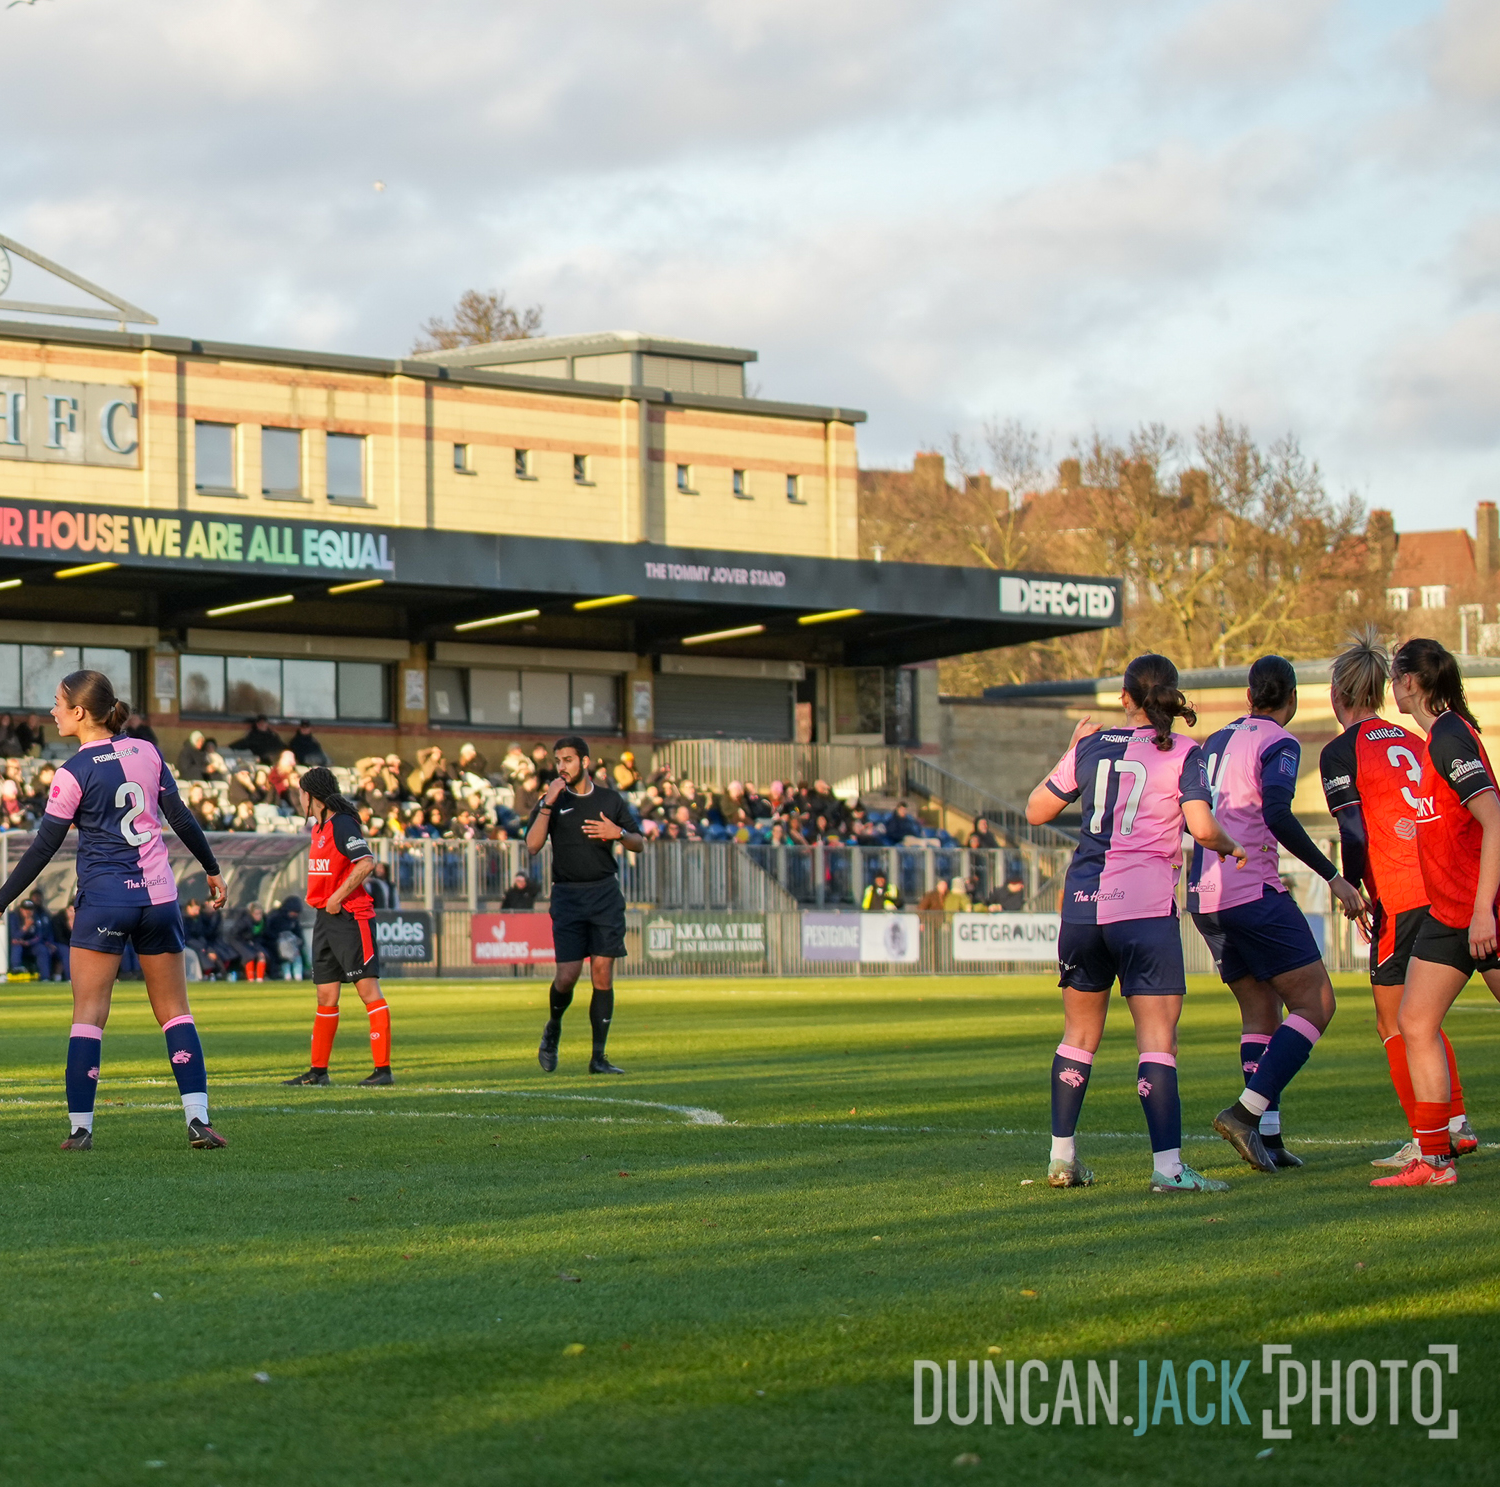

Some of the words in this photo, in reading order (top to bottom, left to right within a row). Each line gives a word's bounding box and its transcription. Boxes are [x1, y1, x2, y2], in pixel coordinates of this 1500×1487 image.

[28, 508, 129, 554] HOUSE
[133, 515, 181, 558] WE
[185, 520, 242, 562] ARE
[247, 525, 299, 565] ALL
[304, 529, 394, 571] EQUAL
[645, 562, 667, 579] THE
[668, 563, 710, 582] TOMMY
[711, 567, 749, 584] JOVER
[750, 569, 786, 587] STAND
[1000, 576, 1115, 618] DEFECTED
[1365, 727, 1396, 740] utilita
[1386, 745, 1422, 809] 3
[1090, 758, 1147, 835] 17
[115, 781, 152, 847] 2
[316, 858, 330, 871] SKY
[124, 879, 140, 889] The
[1073, 890, 1089, 902] The
[705, 923, 723, 939] ON
[726, 923, 739, 939] AT
[742, 923, 764, 939] THE
[380, 943, 425, 957] interiors
